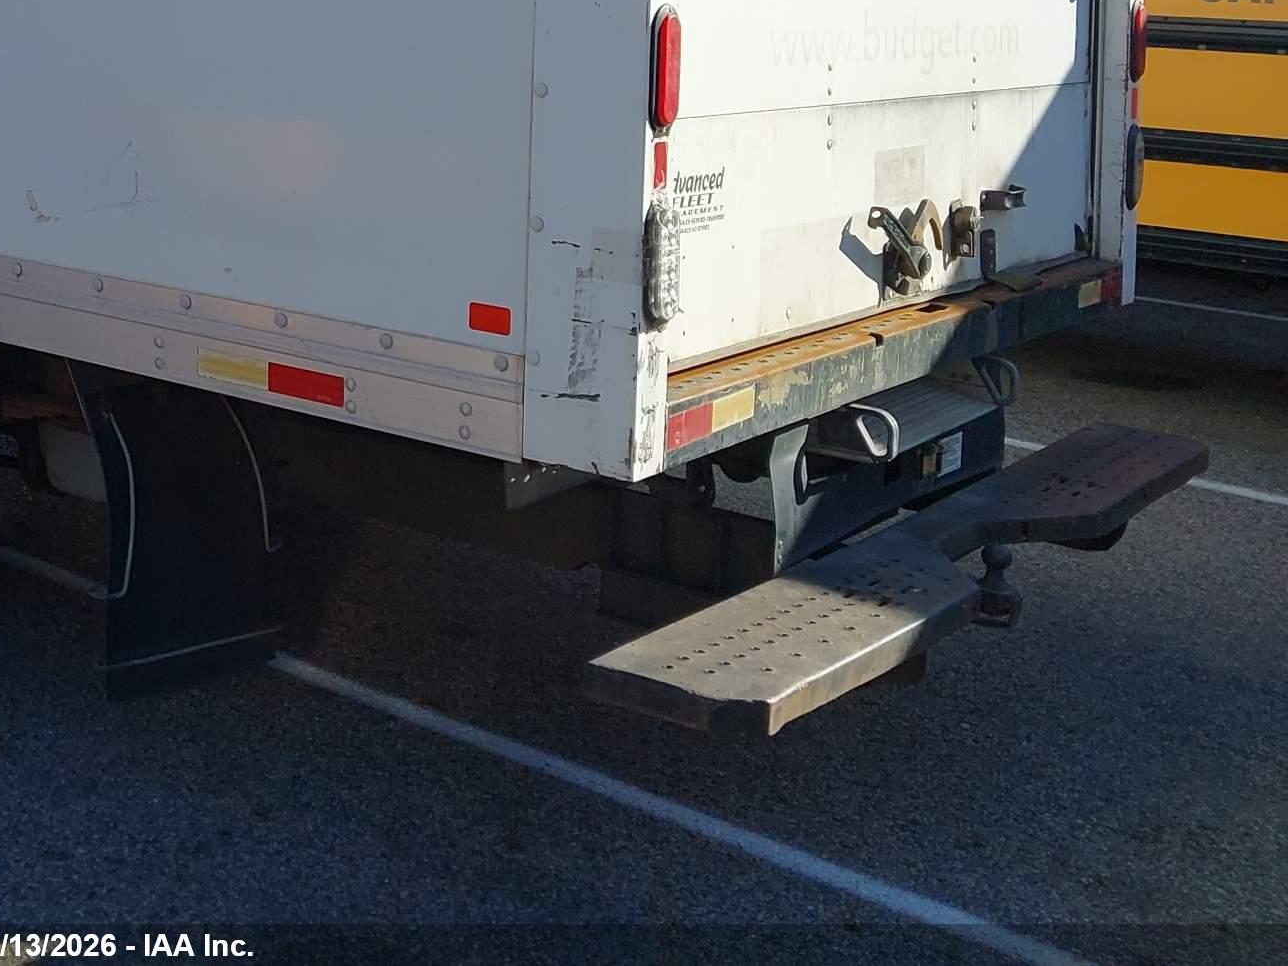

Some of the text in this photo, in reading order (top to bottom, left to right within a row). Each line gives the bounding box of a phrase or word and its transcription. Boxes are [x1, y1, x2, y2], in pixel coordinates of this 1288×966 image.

[768, 5, 1021, 75] www.budget.com
[673, 165, 726, 195] dvanced
[672, 192, 715, 209] FLEET
[680, 205, 725, 217] AGEMENT
